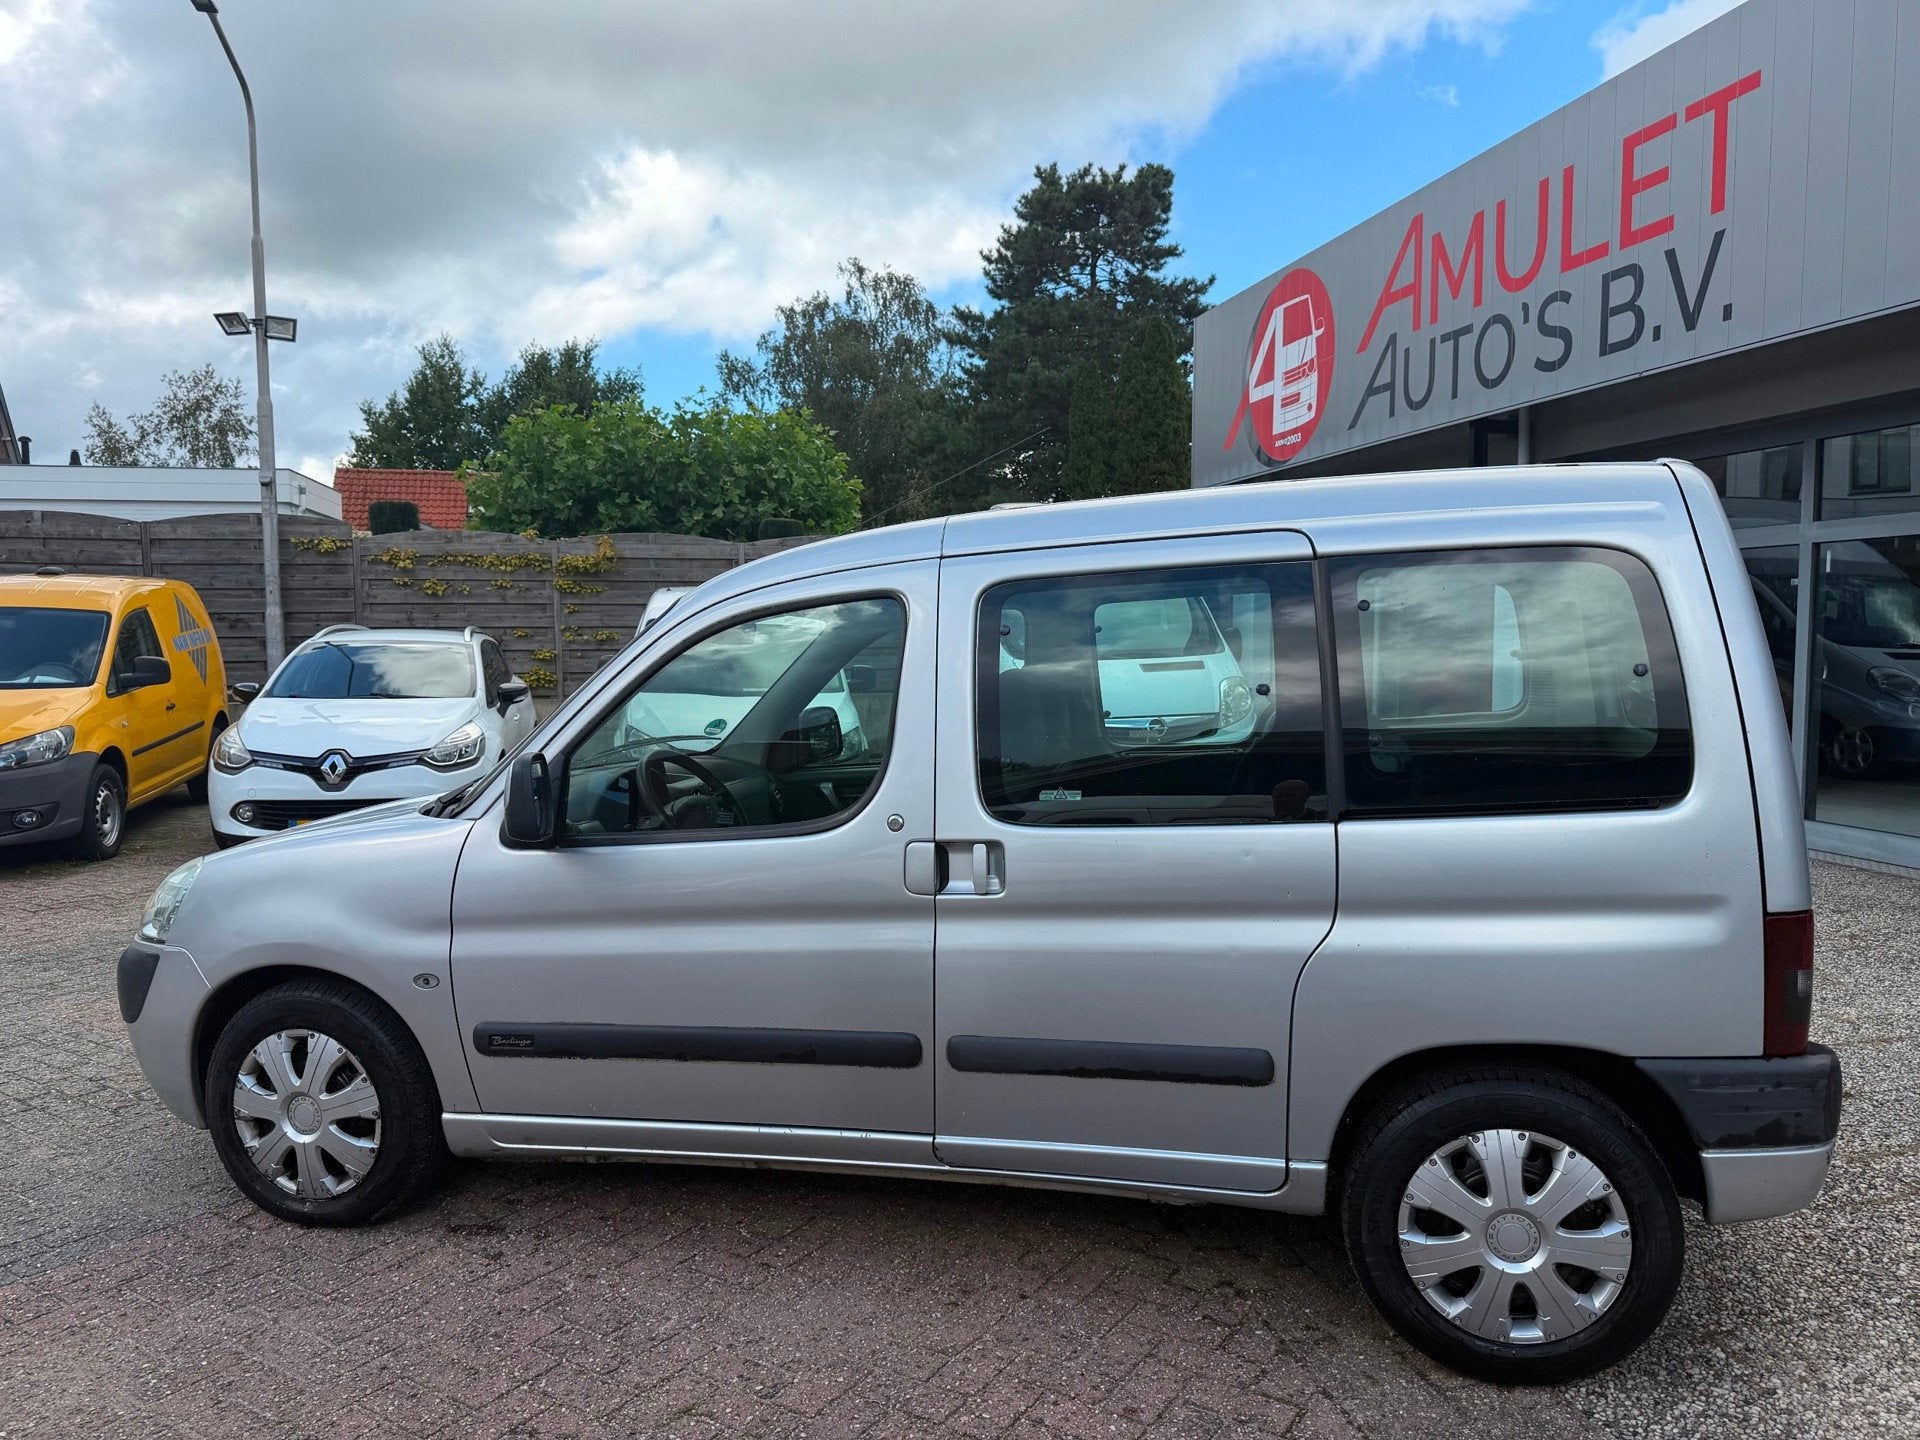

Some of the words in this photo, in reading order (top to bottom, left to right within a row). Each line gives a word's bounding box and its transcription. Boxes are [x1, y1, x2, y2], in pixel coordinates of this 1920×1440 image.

[1356, 70, 1761, 355] AMULET
[1348, 290, 1573, 430] AUTO'S
[1599, 229, 1733, 358] B.V.
[491, 1036, 532, 1046] Berlingo
